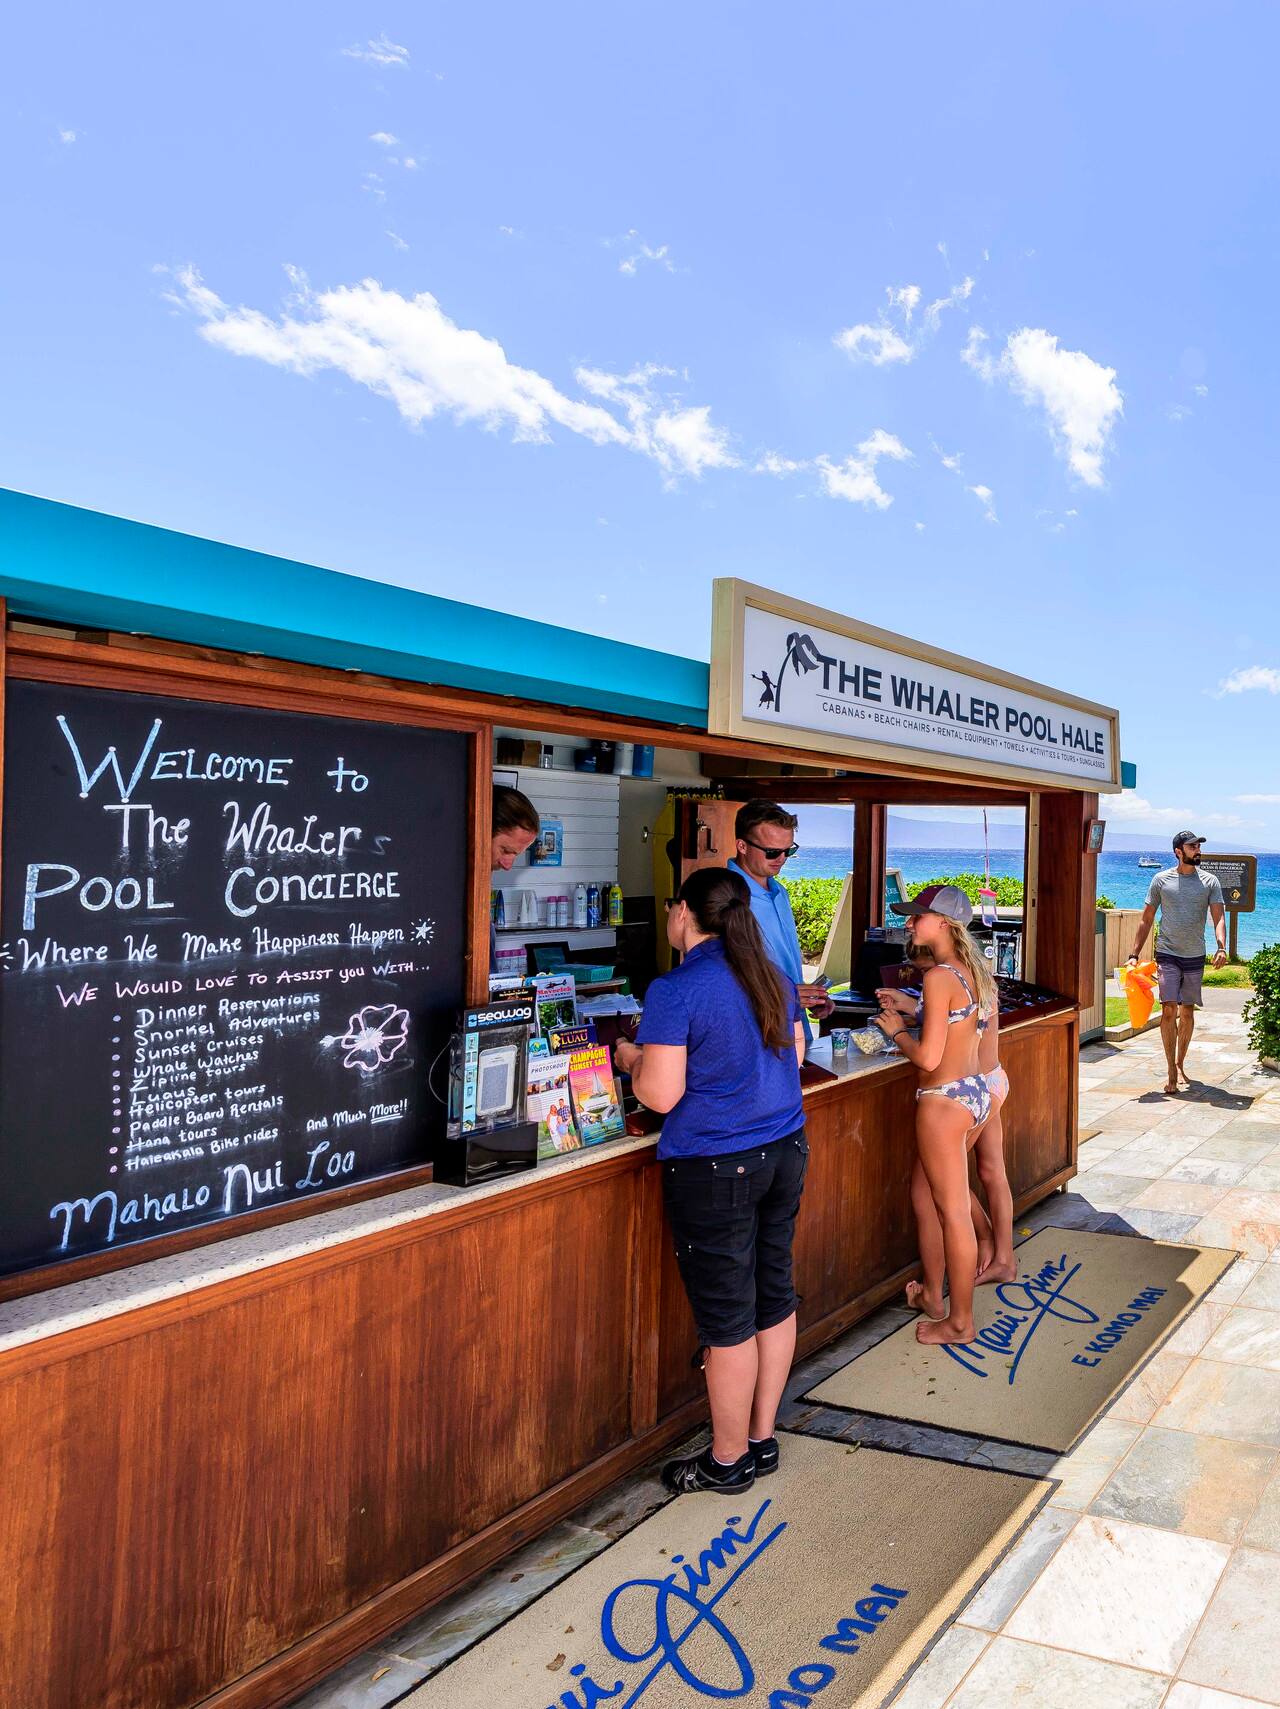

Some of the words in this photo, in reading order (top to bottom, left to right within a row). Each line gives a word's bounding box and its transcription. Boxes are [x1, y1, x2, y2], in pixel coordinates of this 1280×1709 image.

[817, 654, 882, 703] THE
[890, 674, 1000, 730] WHALER
[1005, 707, 1057, 744] POOL
[1062, 722, 1104, 754] HALE
[822, 702, 865, 719] CABANAS
[874, 713, 901, 727] BEACH
[903, 720, 931, 733] CHAIRS
[937, 727, 962, 740] RENTAL
[964, 733, 998, 746] EQUIPMENT
[1004, 741, 1025, 753] TOWELS
[1030, 747, 1056, 759] ACTIVITIES
[1061, 753, 1075, 763] TOURS
[1079, 757, 1105, 769] SUNGLASSES
[327, 757, 369, 792] to
[104, 804, 190, 848] The
[22, 863, 174, 931] POOL
[18, 937, 108, 972] Where
[124, 934, 158, 962] We
[182, 932, 241, 963] Make
[253, 926, 339, 956] Happiness
[349, 923, 404, 950] Happen
[56, 982, 98, 1008] WE
[195, 975, 238, 991] LOVE
[248, 973, 267, 985] TO
[276, 969, 333, 985] ASSIST
[136, 1004, 207, 1028] Dinner
[218, 993, 320, 1016] Reservations
[477, 1007, 532, 1022] seawag
[134, 1023, 214, 1046] Snorkel
[229, 1010, 320, 1031] Adventures
[562, 1032, 588, 1045] LUAU
[135, 1042, 196, 1063] Sunset
[198, 1049, 259, 1069] Watches
[569, 1048, 606, 1065] CHAMPAGNE
[570, 1061, 593, 1072] SUNSET
[595, 1058, 608, 1067] SAIL
[130, 1071, 197, 1092] Zipline
[206, 1064, 246, 1077] tours
[129, 1090, 217, 1117] Helicopter
[224, 1084, 266, 1099] tours
[132, 1087, 196, 1106] Luaus
[130, 1115, 180, 1139] Paddle
[186, 1107, 224, 1124] Board
[230, 1095, 283, 1118] Rentals
[306, 1117, 328, 1132] And
[333, 1110, 366, 1127] Much
[126, 1136, 171, 1154] Hana
[178, 1127, 217, 1143] tours
[210, 1136, 239, 1154] Bike
[244, 1127, 278, 1145] rides
[295, 1140, 355, 1189] Loa
[1127, 1287, 1168, 1311] MAI
[940, 1311, 1028, 1377] Maui
[1085, 1312, 1142, 1355] KOMO
[1072, 1354, 1102, 1368] E
[819, 1583, 909, 1655] MAI
